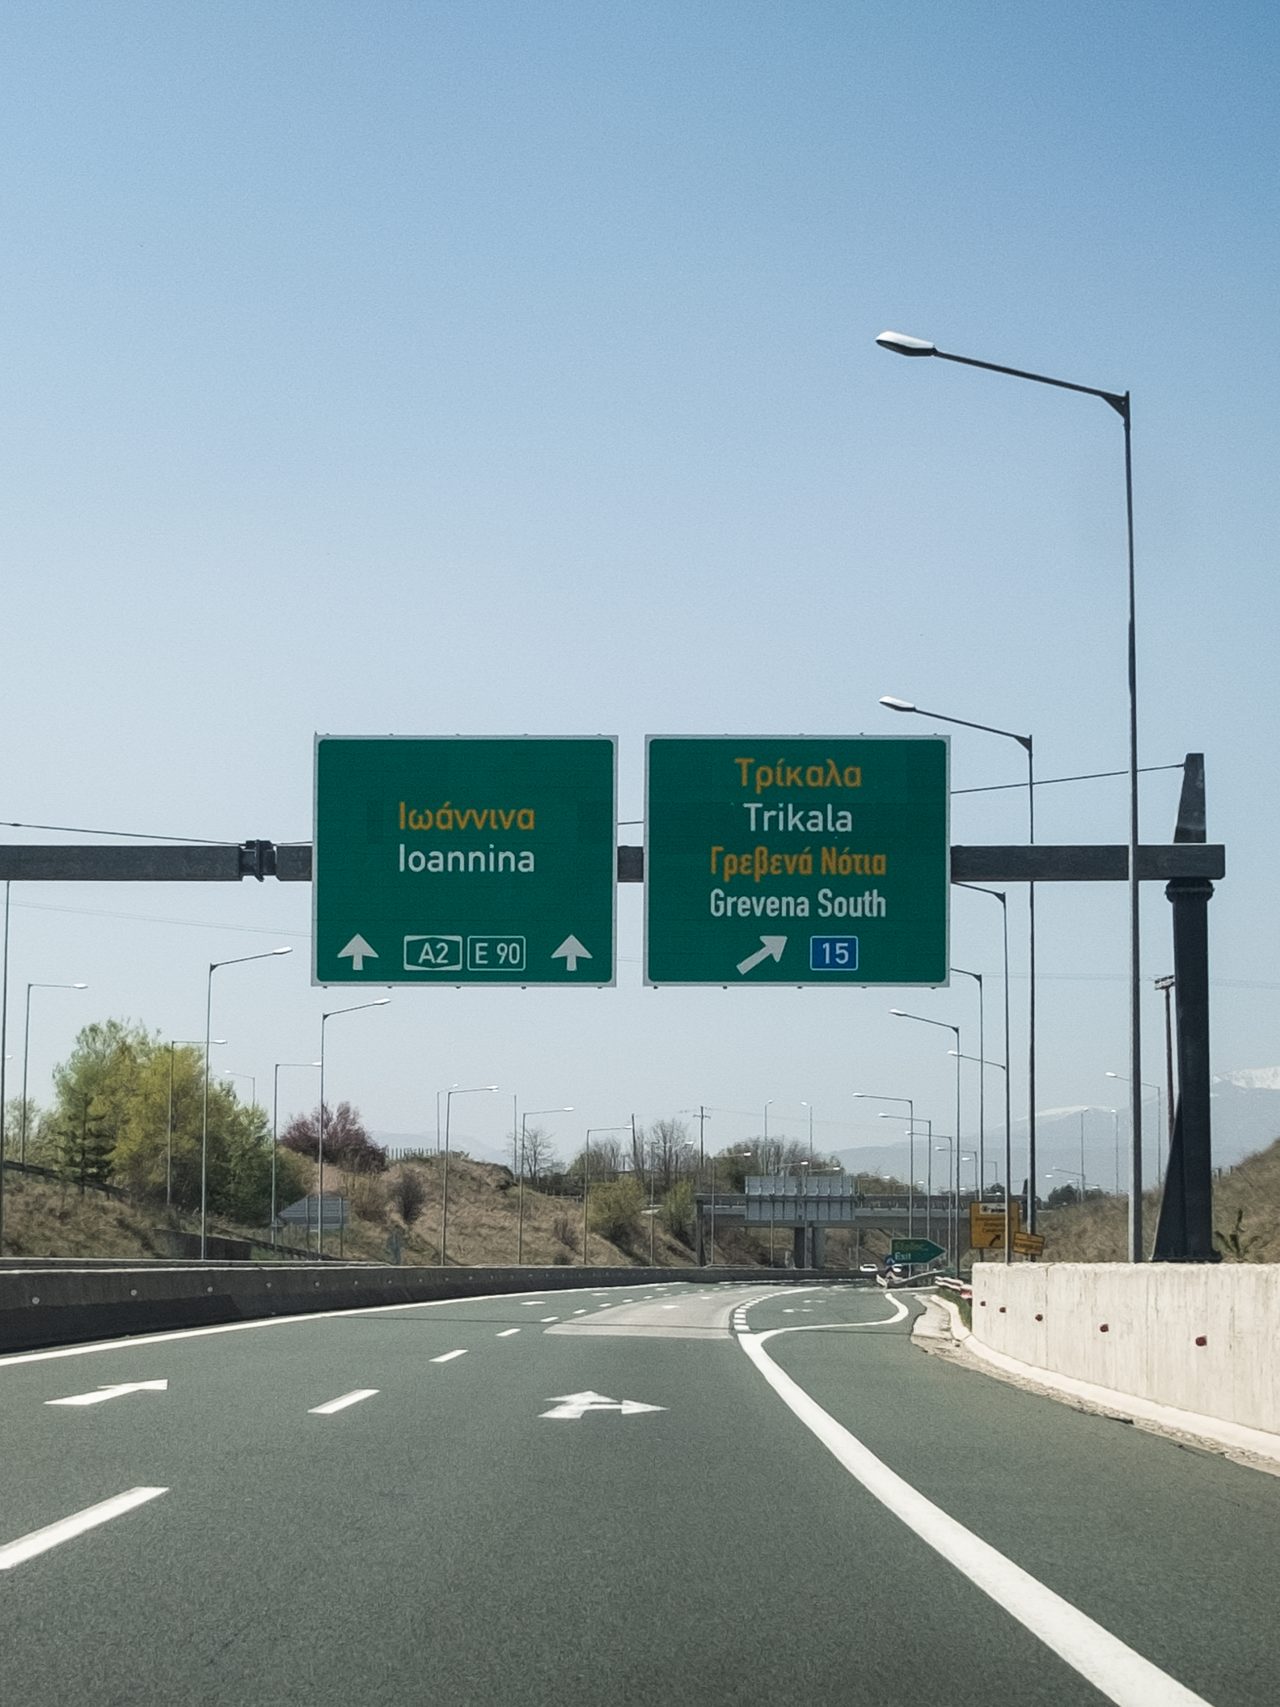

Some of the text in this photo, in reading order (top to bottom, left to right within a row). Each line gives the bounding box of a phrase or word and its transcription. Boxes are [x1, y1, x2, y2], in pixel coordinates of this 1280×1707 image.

[735, 758, 862, 794] Τρίκαλα
[399, 801, 535, 831] Ιωάννινα
[743, 803, 852, 832] Trikala
[399, 843, 535, 873] Ioannina
[711, 846, 886, 882] Γρεβενά Νότια
[710, 888, 886, 918] Grevena South
[418, 942, 449, 964] A2
[475, 942, 520, 964] E 90
[822, 943, 849, 964] 15
